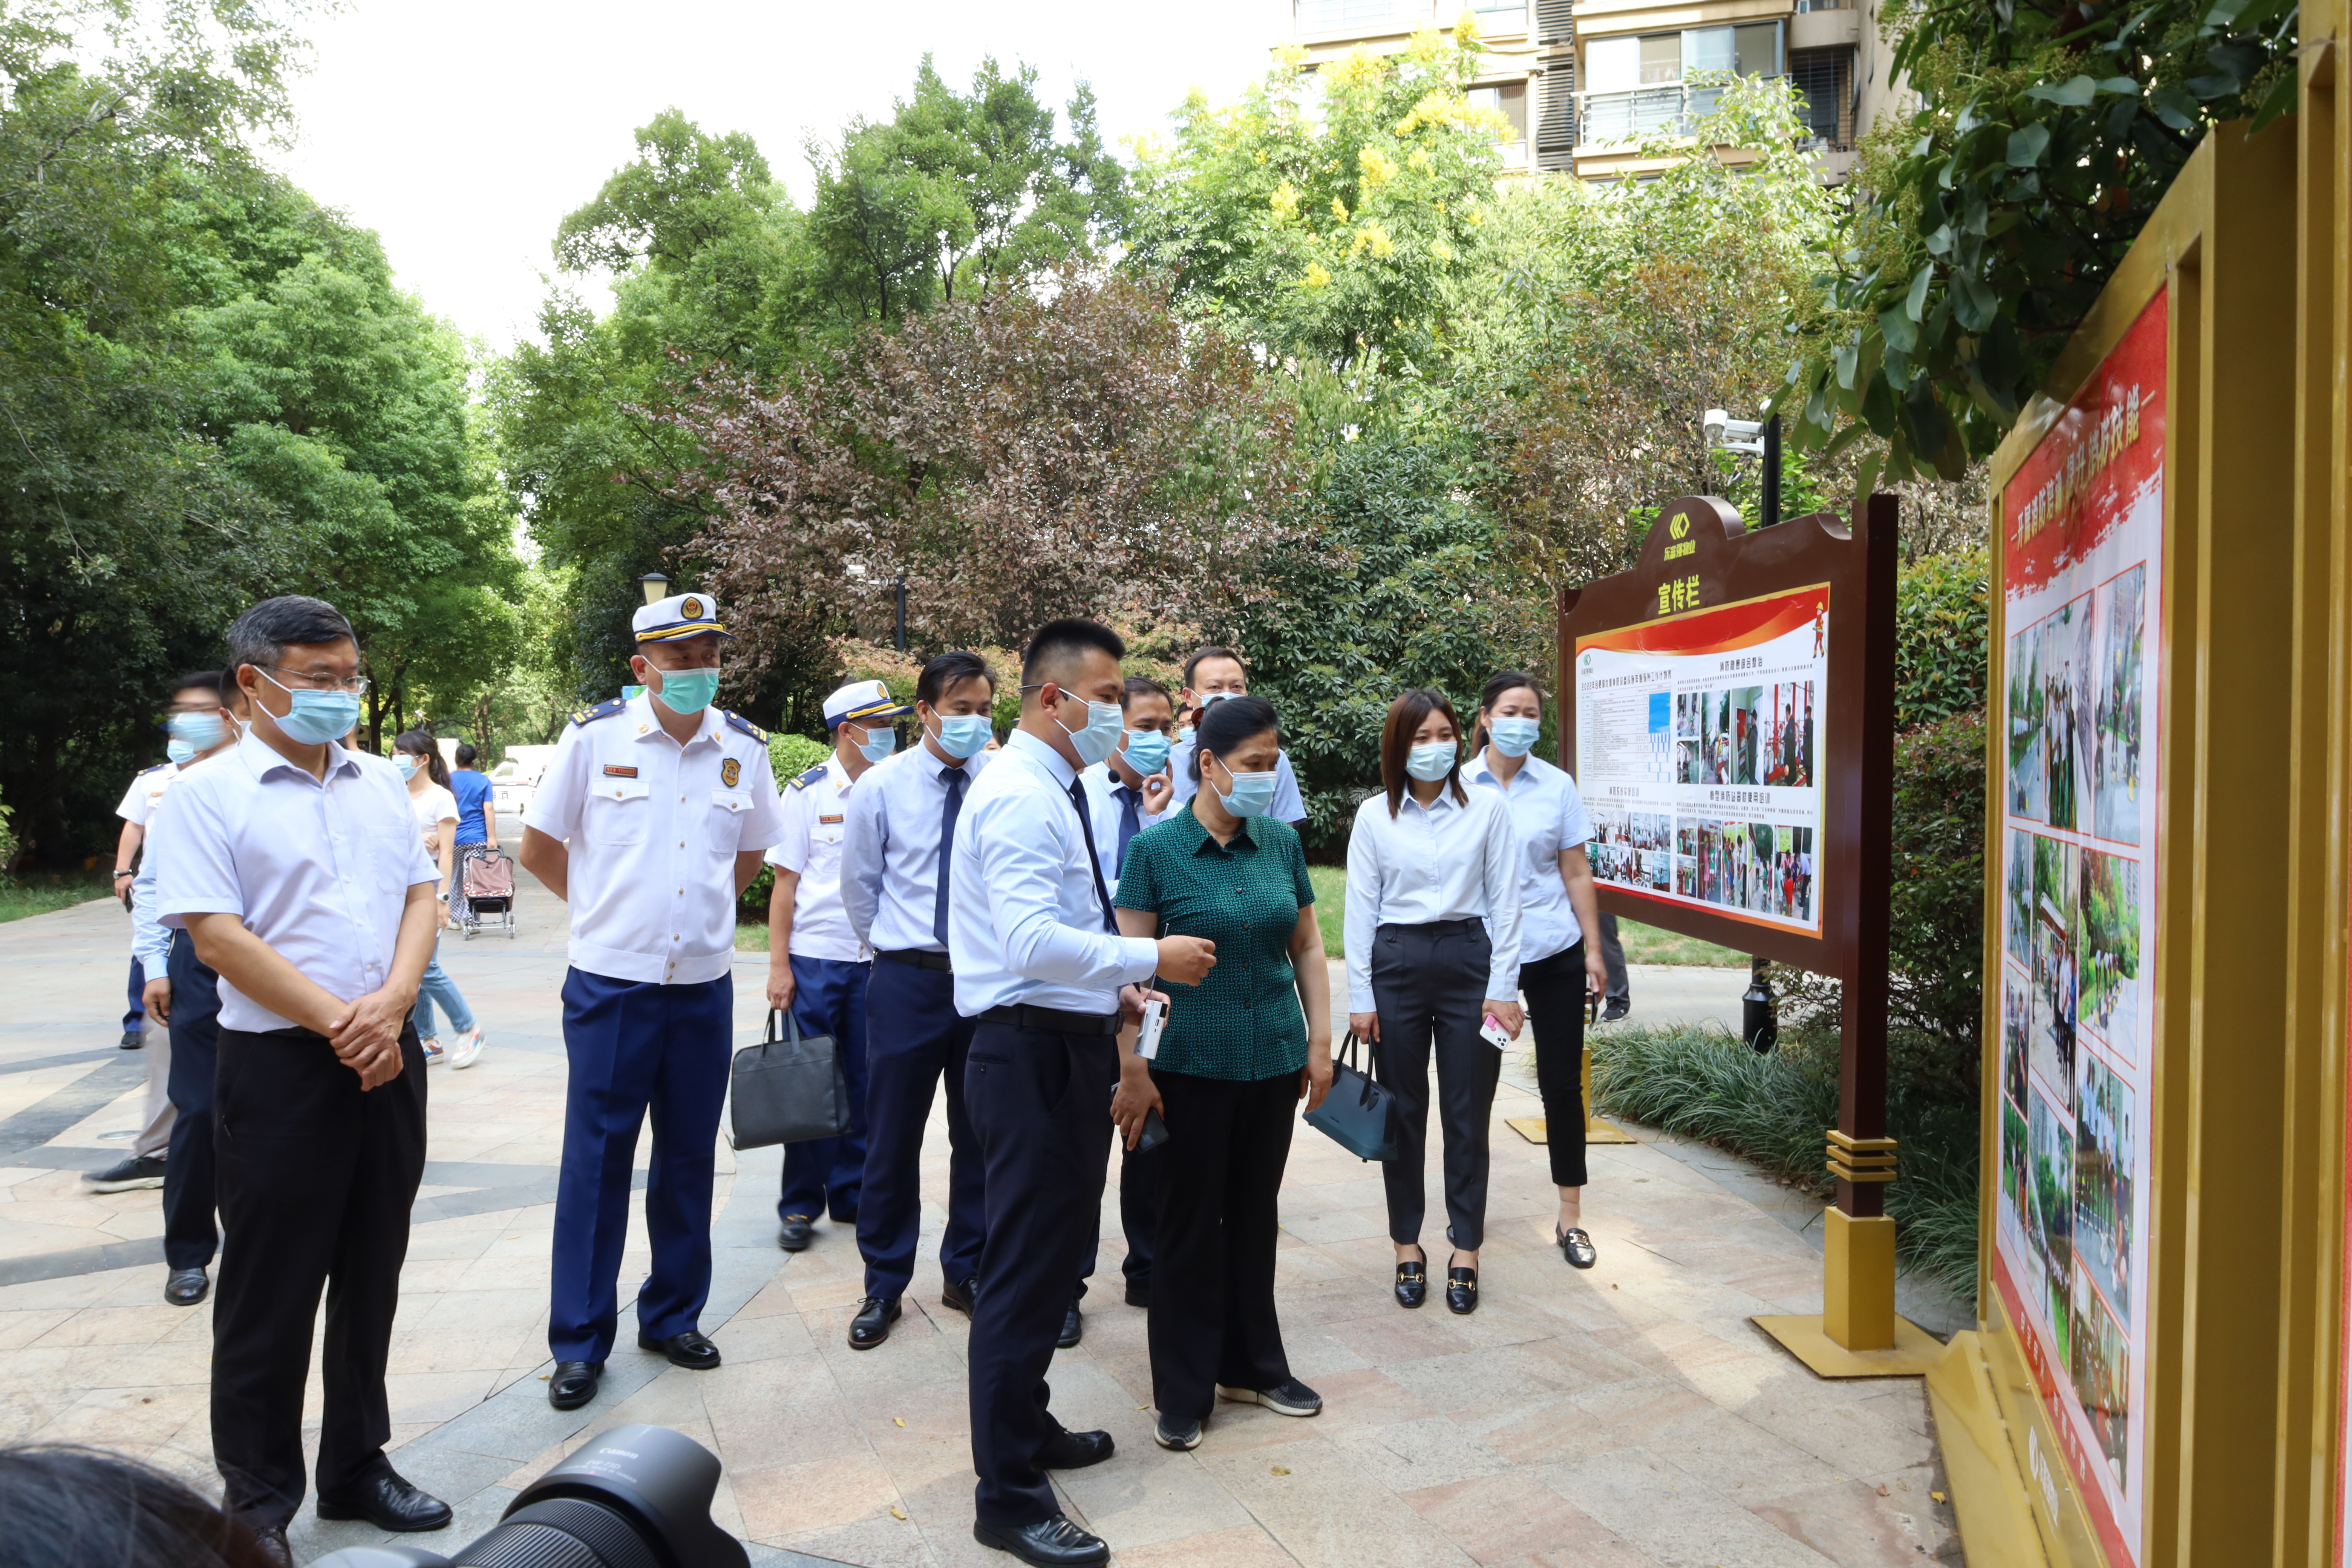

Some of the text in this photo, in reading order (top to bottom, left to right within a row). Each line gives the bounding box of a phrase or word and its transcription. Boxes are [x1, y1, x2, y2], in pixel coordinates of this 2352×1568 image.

[1664, 539, 1696, 561] 乐富强物业
[1658, 574, 1700, 615] 宣传栏
[599, 1448, 639, 1459] Canon
